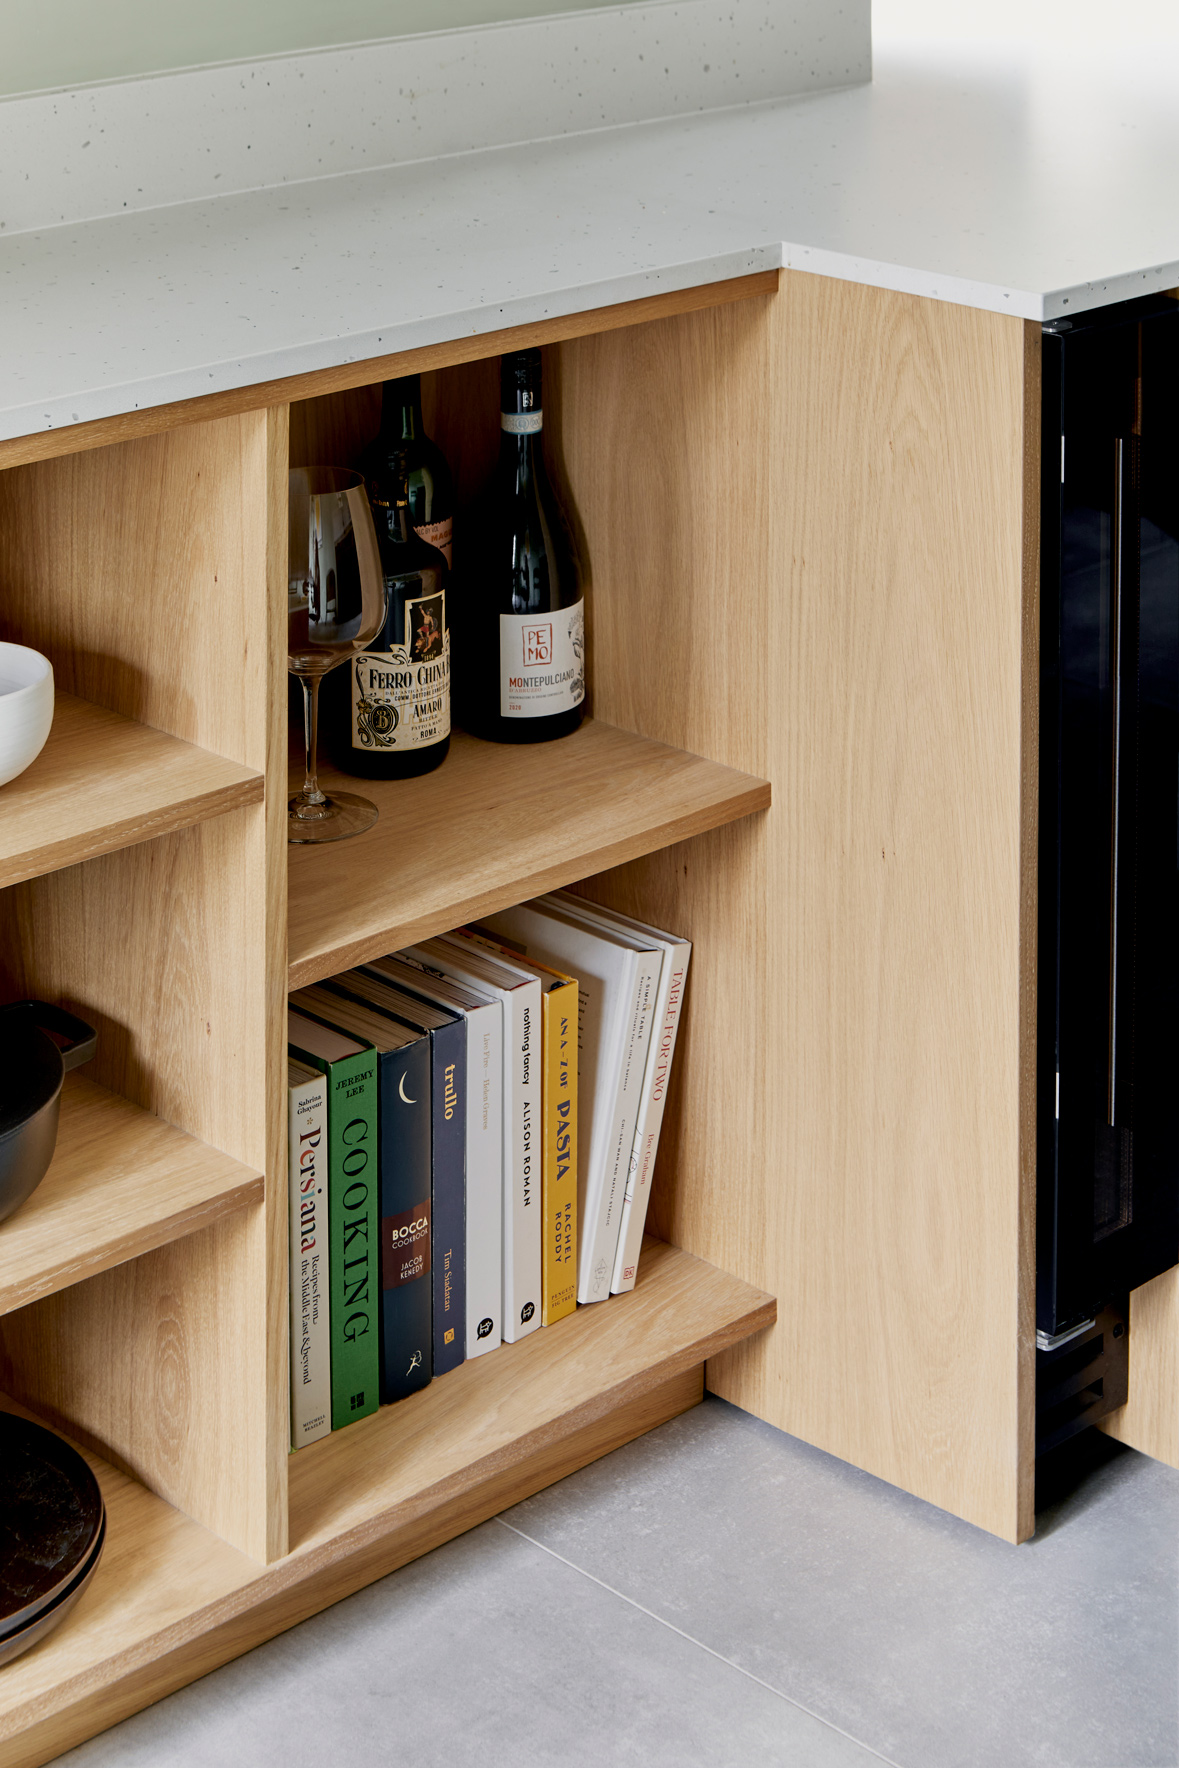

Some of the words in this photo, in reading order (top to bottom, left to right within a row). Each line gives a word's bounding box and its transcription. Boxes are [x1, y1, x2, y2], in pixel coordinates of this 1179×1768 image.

[369, 668, 412, 689] FERRO
[417, 660, 446, 686] CHINA
[509, 668, 575, 688] MONTEPULCIANO
[413, 697, 442, 719] AMARO
[420, 727, 437, 739] ROMA
[642, 984, 650, 1012] SIMPLE
[666, 967, 684, 1022] TABLE
[521, 1007, 531, 1052] nothing
[560, 1017, 569, 1036] AN
[637, 1015, 645, 1039] TABLE
[659, 1025, 674, 1059] FOR
[335, 1068, 374, 1091] JEREMY
[522, 1053, 531, 1085] fancy
[652, 1060, 668, 1102] TWO
[298, 1094, 322, 1108] Sabrina
[346, 1084, 365, 1099] LEE
[444, 1063, 457, 1120] trullo
[297, 1101, 323, 1115] Ghayour
[523, 1102, 531, 1153] ALISON
[556, 1099, 571, 1182] PASTA
[300, 1125, 322, 1255] Persiana
[523, 1156, 531, 1207] ROMAN
[342, 1118, 370, 1344] COOKING
[392, 1216, 429, 1241] BOCCA
[392, 1228, 428, 1250] COOKBOOK
[564, 1202, 572, 1264] RACHEL
[301, 1259, 310, 1276] the
[400, 1262, 424, 1280] KENEDY
[401, 1255, 423, 1271] JACOB
[444, 1248, 452, 1271] Tim
[310, 1254, 320, 1294] Recipes
[301, 1277, 311, 1313] Middle
[444, 1271, 453, 1312] Siadatan
[551, 1285, 574, 1300] PENGUIN
[551, 1301, 560, 1309] FIG
[561, 1293, 574, 1302] TREE
[312, 1294, 321, 1325] from
[302, 1313, 310, 1336] East
[301, 1346, 312, 1385] beyond
[302, 1414, 325, 1428] MITCHELL
